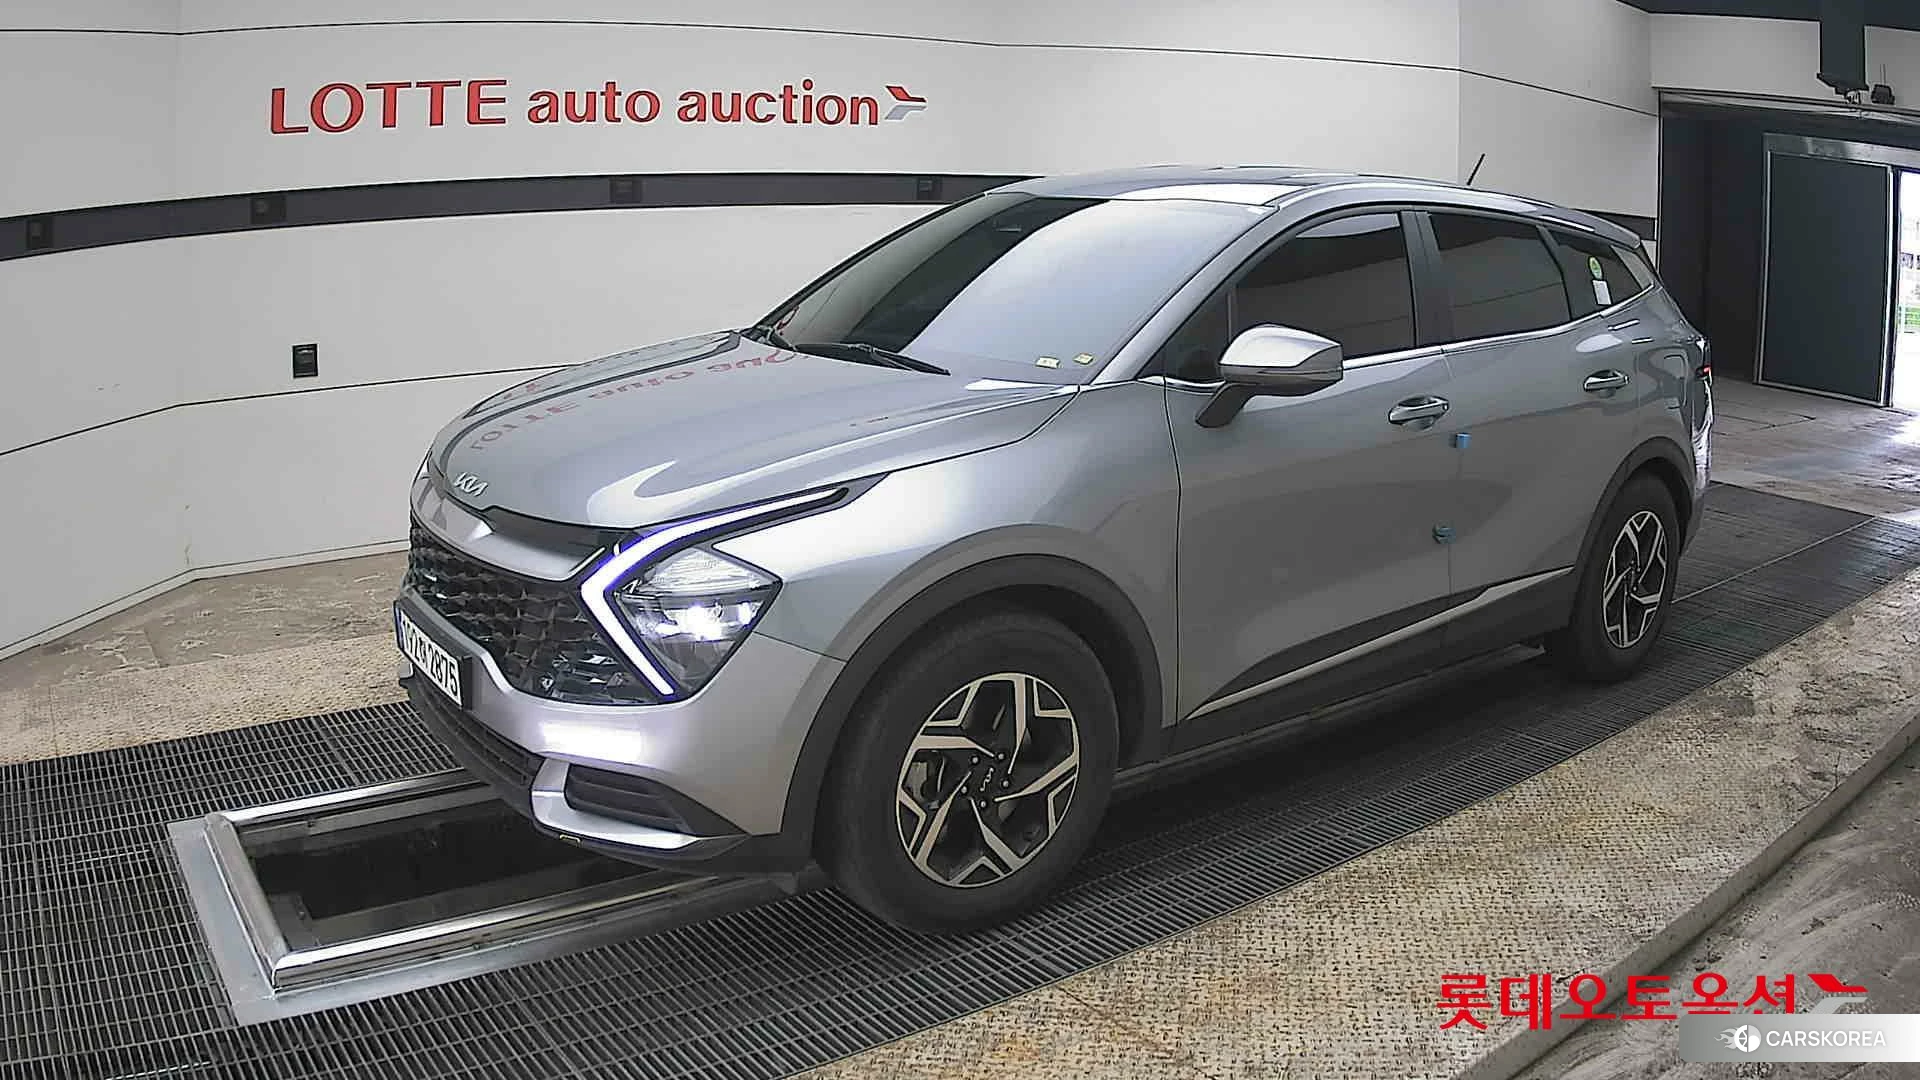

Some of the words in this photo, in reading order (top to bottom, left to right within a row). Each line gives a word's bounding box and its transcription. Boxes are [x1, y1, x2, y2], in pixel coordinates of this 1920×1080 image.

[271, 80, 507, 134] LOTTE
[528, 81, 660, 124] auto
[677, 79, 878, 125] auction
[428, 643, 458, 697] 2875
